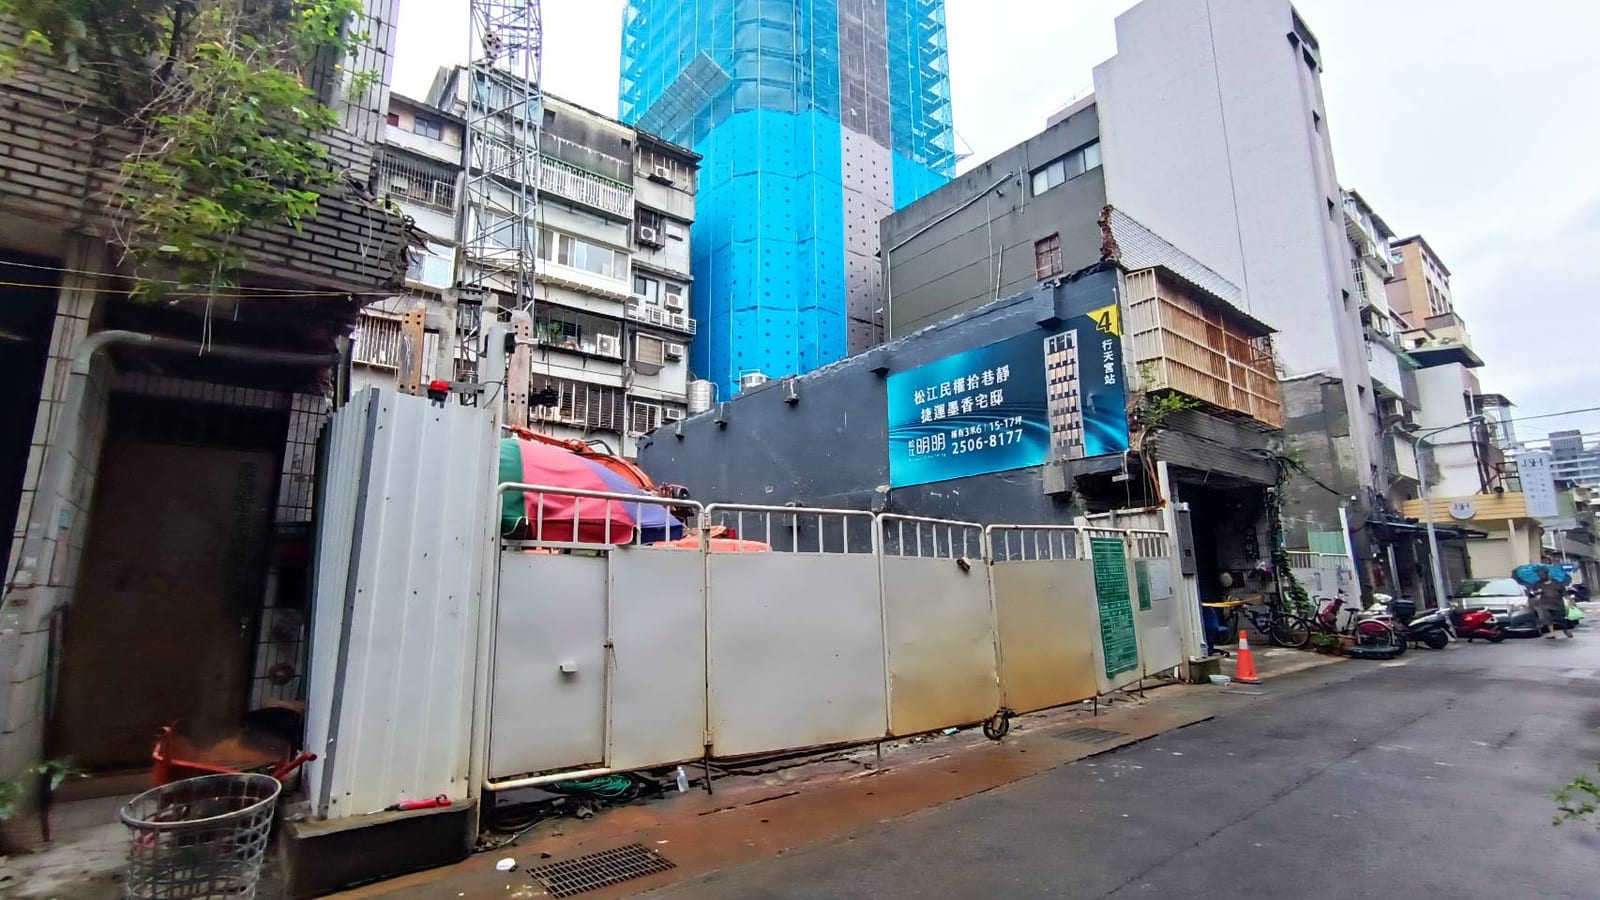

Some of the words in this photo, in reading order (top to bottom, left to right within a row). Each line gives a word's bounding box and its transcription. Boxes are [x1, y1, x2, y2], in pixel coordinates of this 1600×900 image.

[1098, 311, 1112, 331] 4
[1102, 339, 1116, 385] 行天宮站
[914, 364, 1010, 405] 松江民權拾巷靜
[921, 389, 1004, 424] 捷運墨香宅邸
[916, 432, 946, 454] 明明
[952, 429, 1023, 455] 2506-8177
